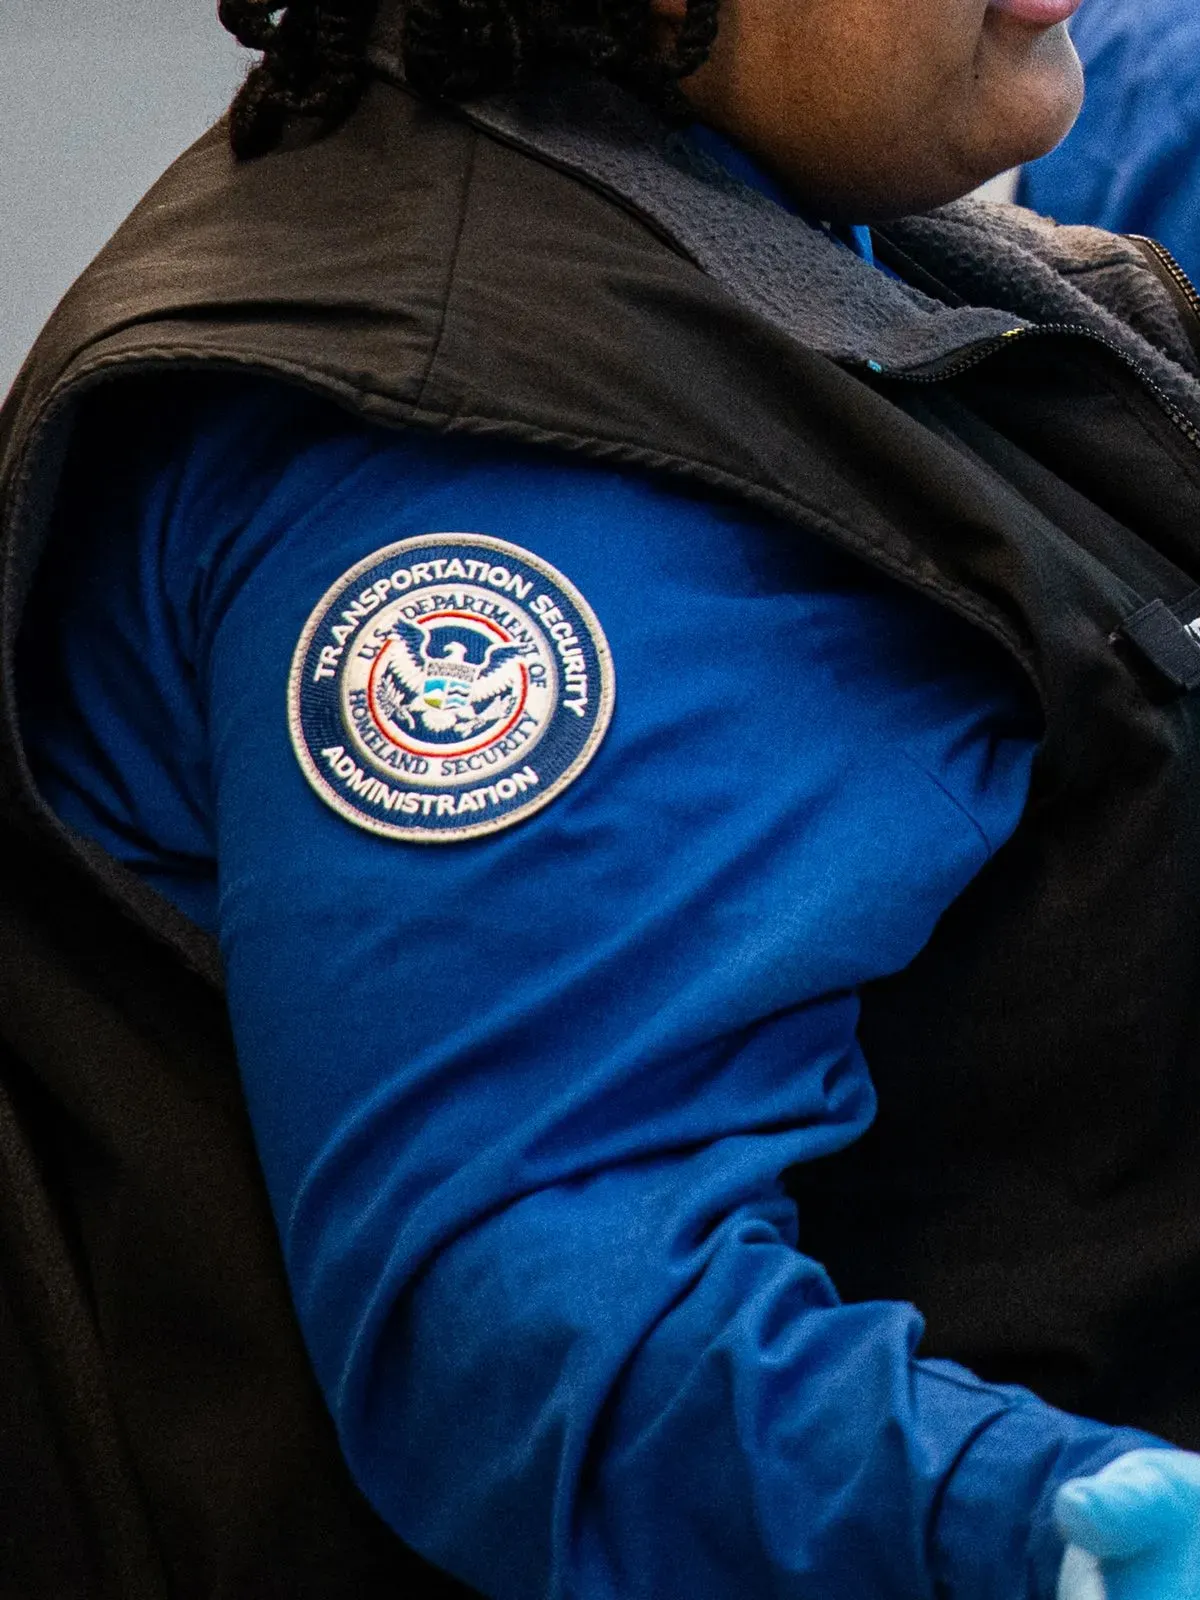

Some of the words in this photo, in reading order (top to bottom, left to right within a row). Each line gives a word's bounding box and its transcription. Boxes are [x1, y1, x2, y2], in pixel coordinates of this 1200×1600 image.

[314, 558, 533, 683] TRANSPORTATION
[529, 594, 588, 717] SECURITY
[400, 593, 540, 657] DEPARTMENT
[528, 663, 547, 688] OF
[349, 688, 429, 775] HOMELAND
[441, 711, 538, 776] SECURITY
[322, 745, 539, 816] ADMINISTRATION
